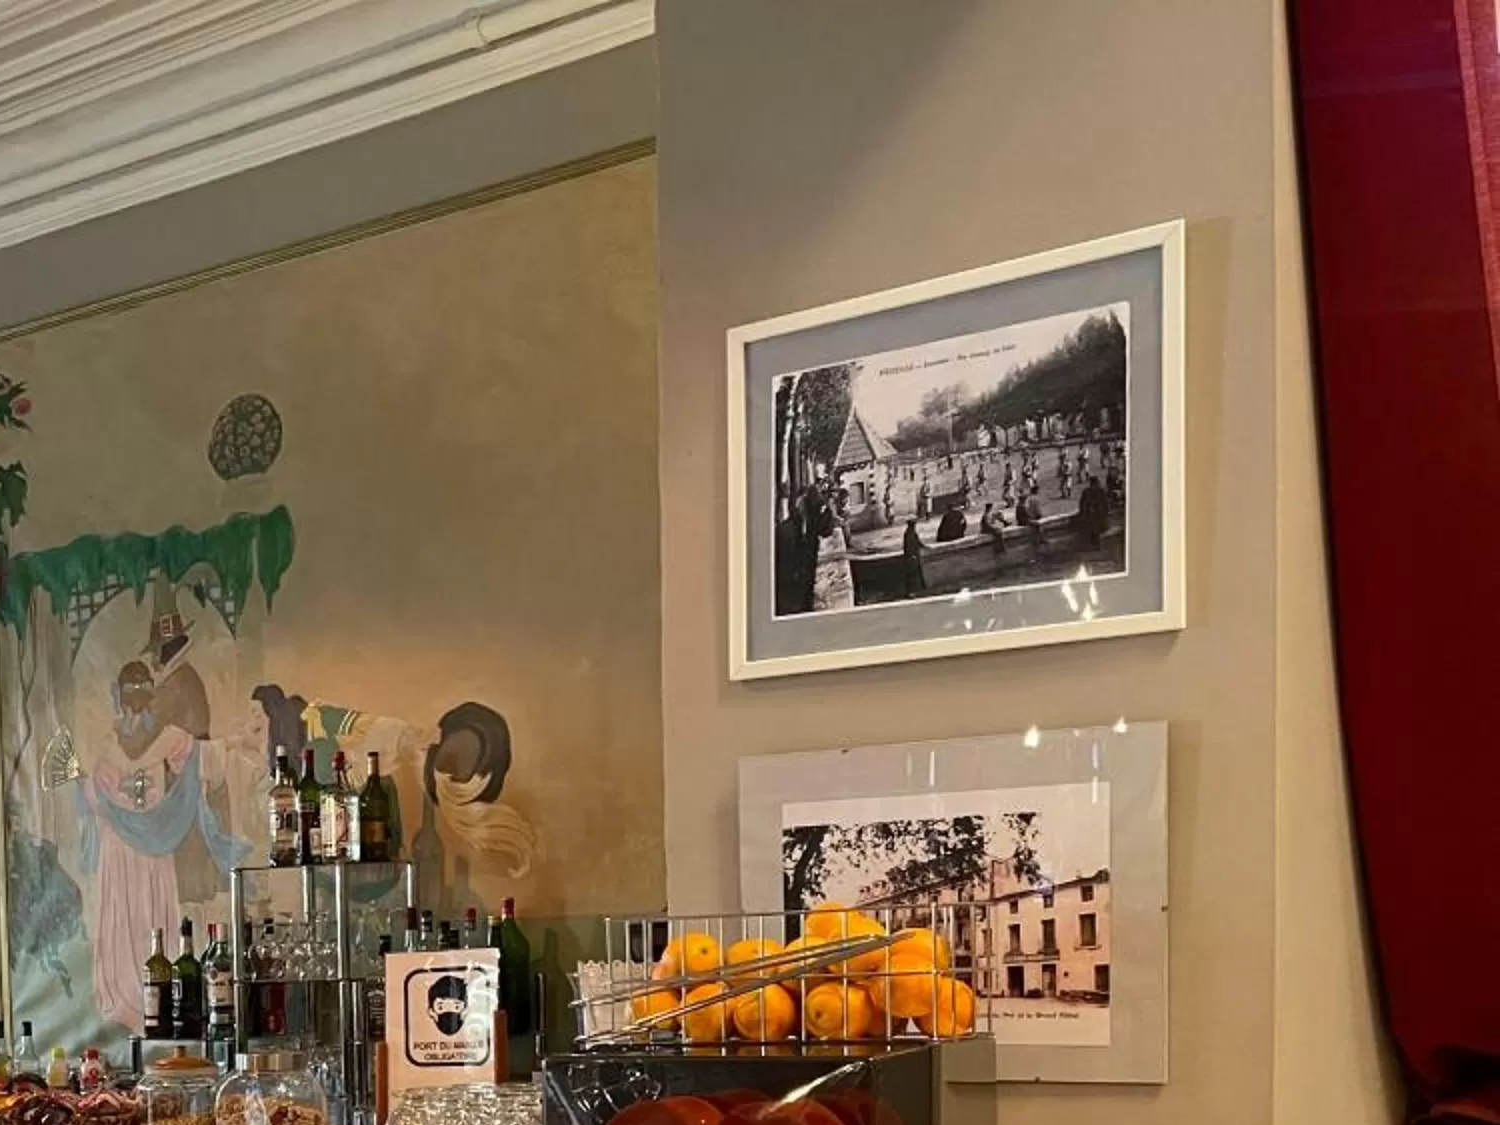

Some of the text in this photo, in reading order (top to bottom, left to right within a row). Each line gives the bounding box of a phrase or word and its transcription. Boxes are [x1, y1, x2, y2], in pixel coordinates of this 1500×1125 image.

[413, 1041, 437, 1050] PORT
[454, 1040, 484, 1049] MAE
[424, 1052, 477, 1060] OBLIGATO
